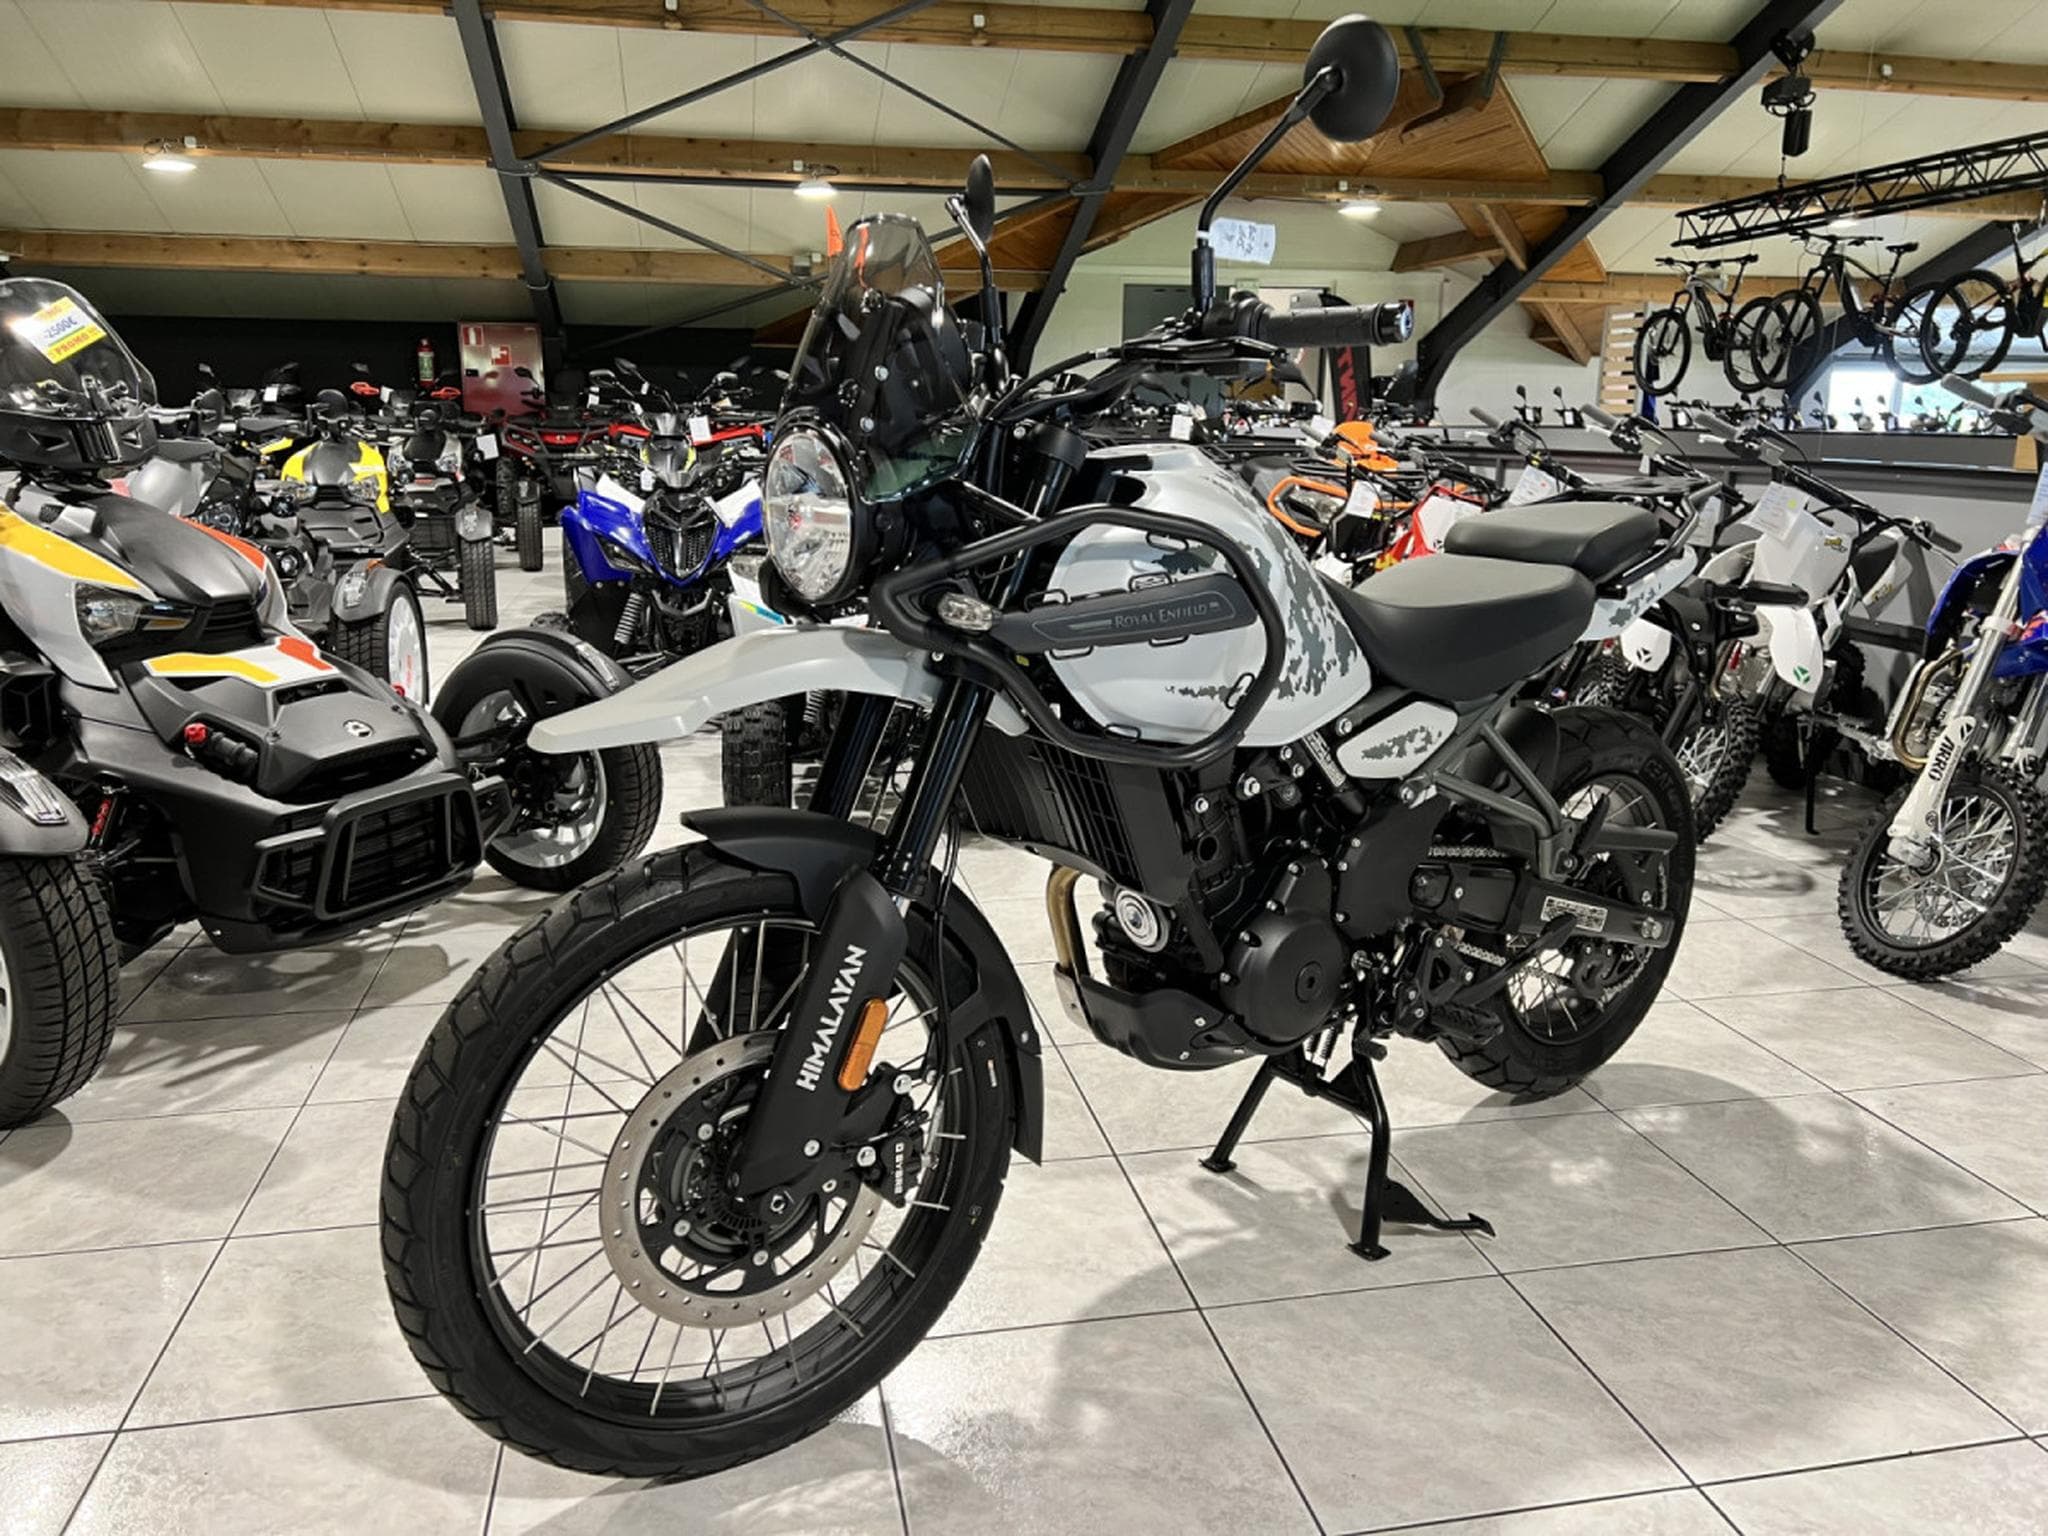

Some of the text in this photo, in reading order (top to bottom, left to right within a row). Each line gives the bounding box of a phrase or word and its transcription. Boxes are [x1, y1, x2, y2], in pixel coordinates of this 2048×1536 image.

[1114, 604, 1208, 629] ROYAL ENFIELD
[796, 943, 867, 1092] HIMALAYAN
